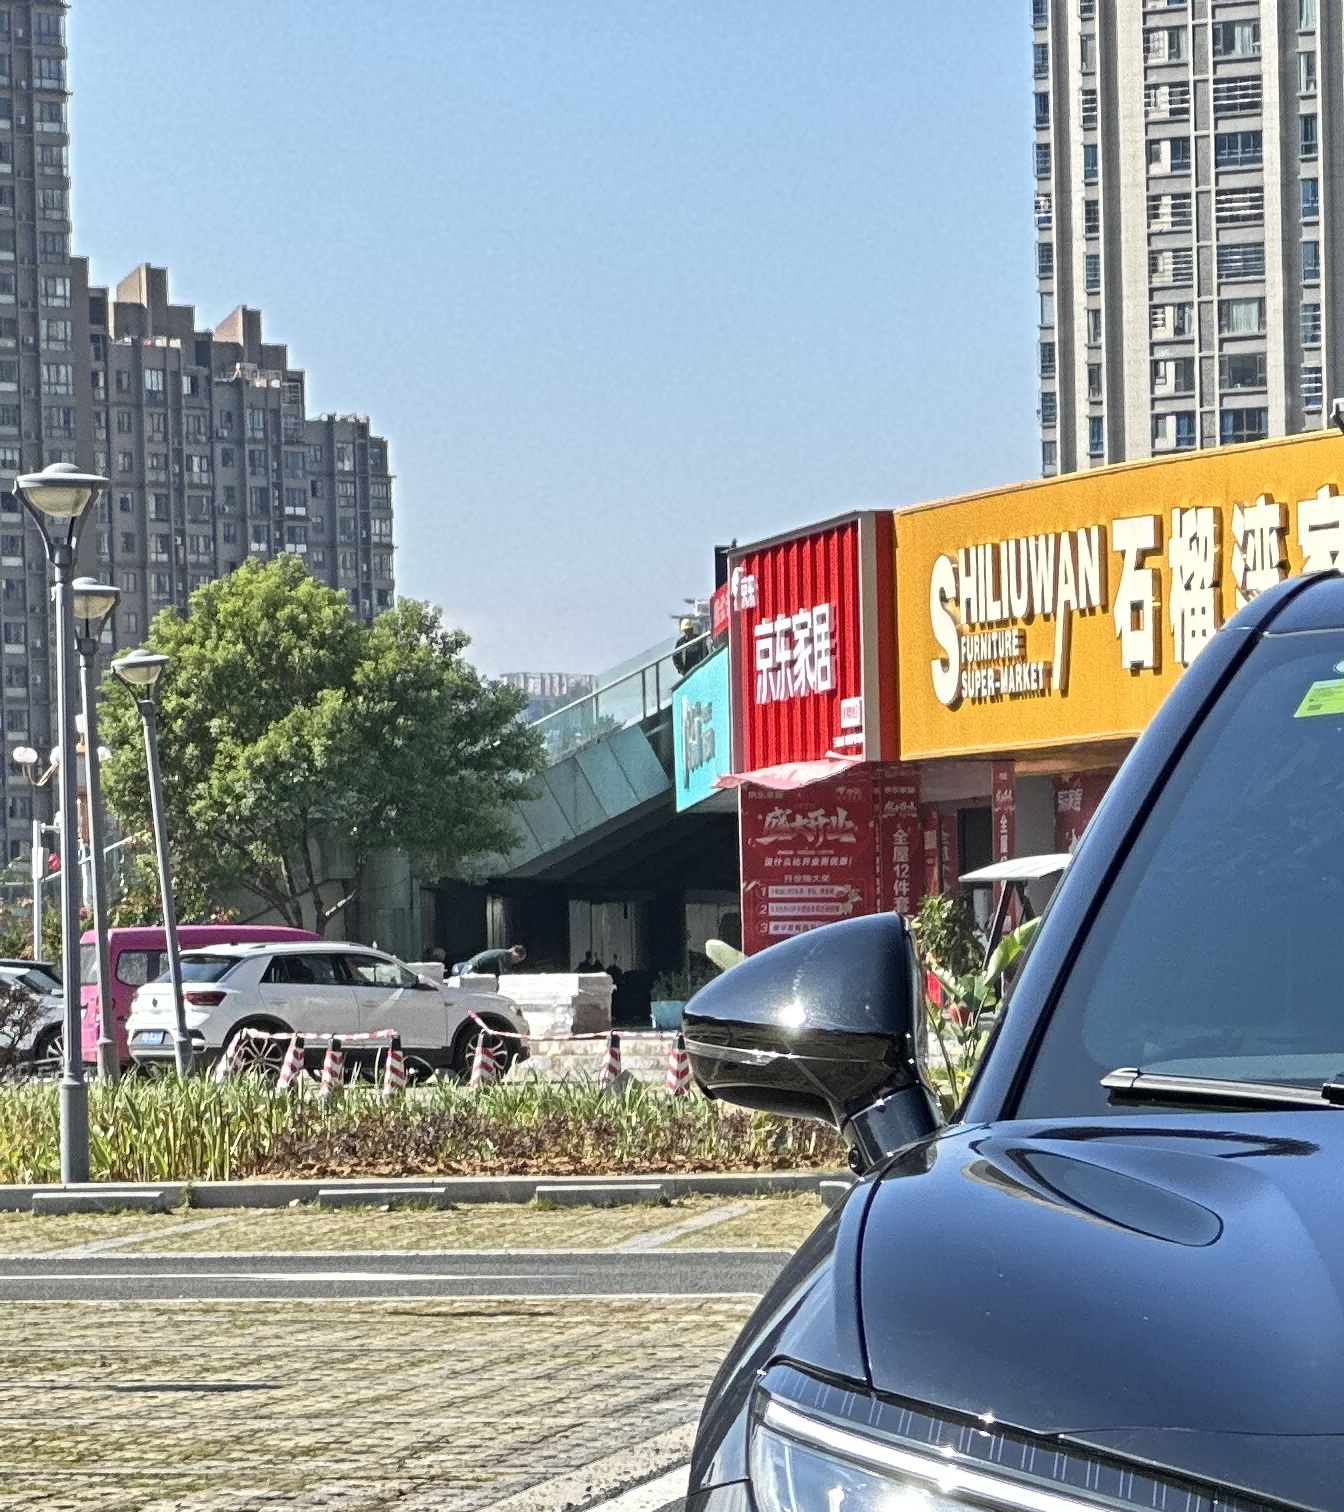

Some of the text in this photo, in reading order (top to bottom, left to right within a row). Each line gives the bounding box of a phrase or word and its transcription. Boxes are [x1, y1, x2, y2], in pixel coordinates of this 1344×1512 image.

[930, 524, 1104, 705] SHILIUWAN
[960, 629, 1021, 663] FURNITURE
[754, 602, 832, 705] 京东家居
[961, 661, 1047, 697] SUPER-MARKET
